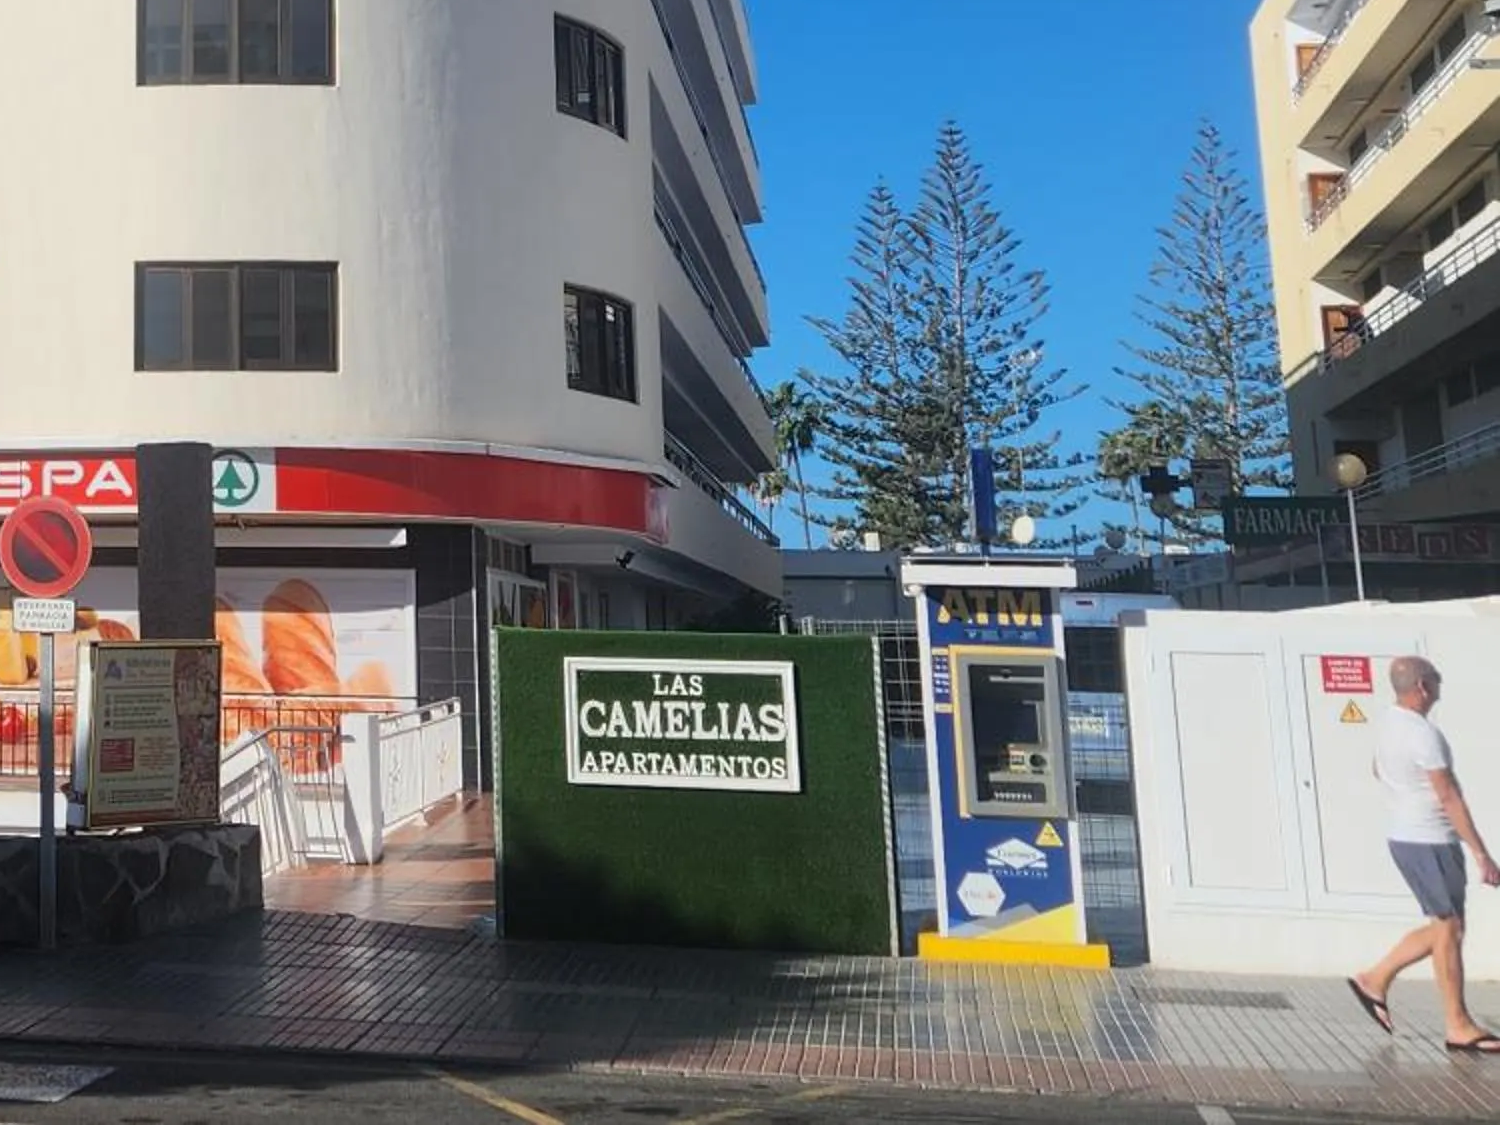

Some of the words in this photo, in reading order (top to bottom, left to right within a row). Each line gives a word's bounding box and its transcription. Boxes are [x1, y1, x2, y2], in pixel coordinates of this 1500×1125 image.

[936, 588, 1044, 627] ATM
[652, 674, 703, 697] LAS
[579, 699, 788, 742] CAMELIAS
[580, 750, 786, 780] APARTAMENTOS
